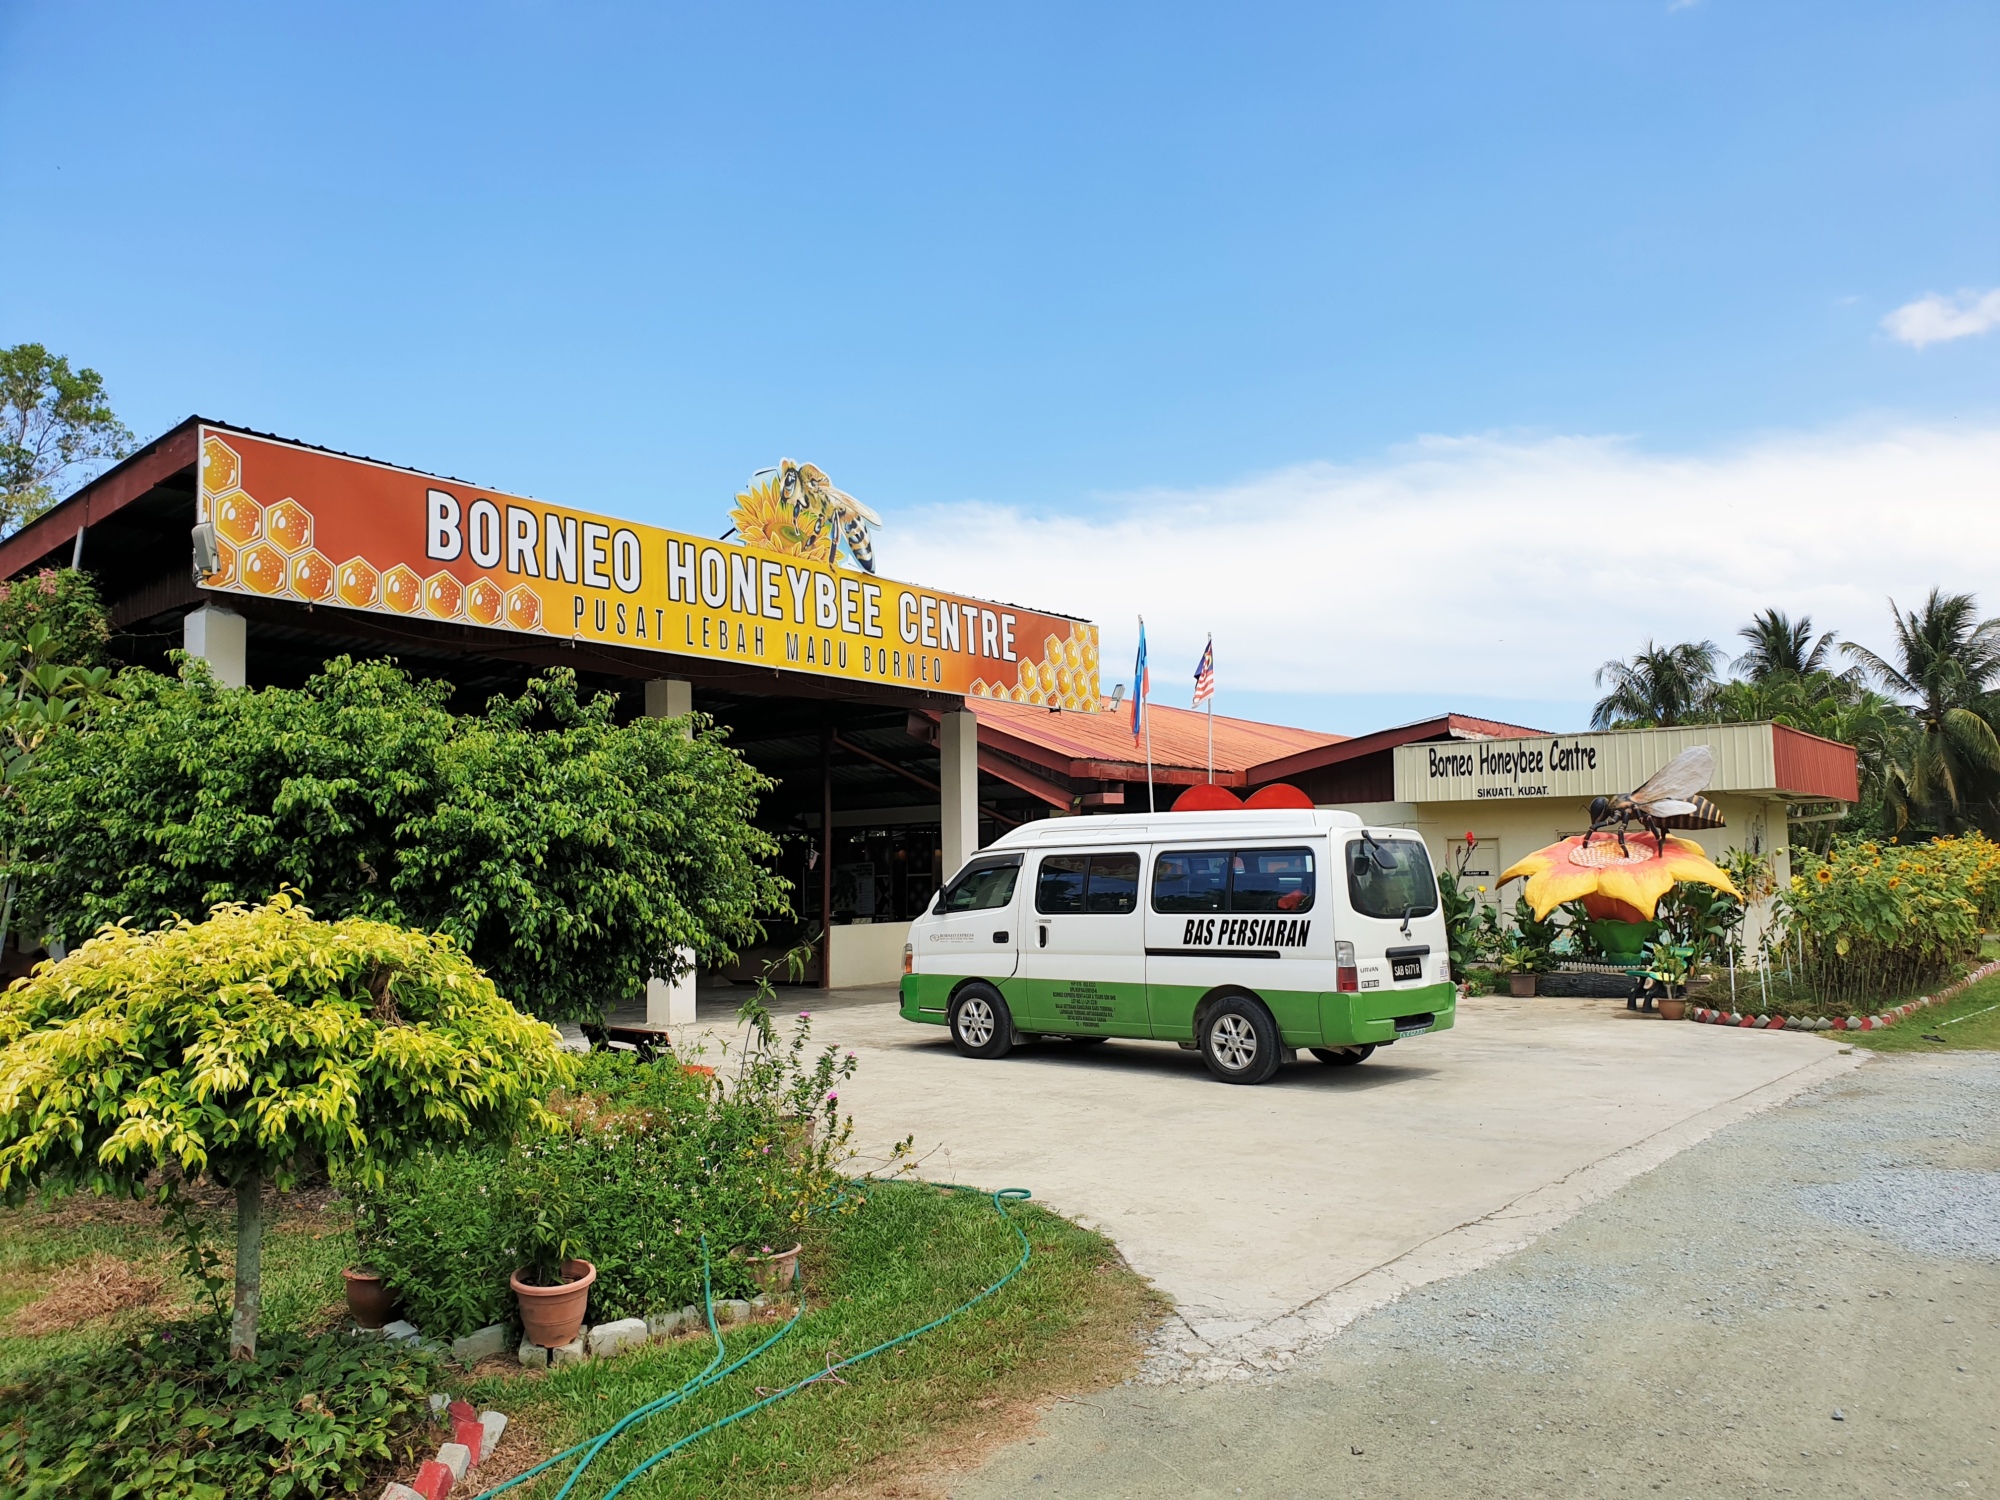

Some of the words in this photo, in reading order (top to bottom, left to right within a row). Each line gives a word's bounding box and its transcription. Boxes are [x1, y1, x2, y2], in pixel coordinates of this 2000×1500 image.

[426, 487, 642, 594] BORNEO
[667, 539, 883, 638] HONEYBEE
[899, 591, 1018, 662] CENTRE
[573, 595, 665, 642] PUSAT
[685, 613, 765, 657] LEBAH
[786, 631, 848, 670] MADU
[863, 645, 943, 684] BORNEO
[1429, 747, 1473, 778] Borneo
[1479, 741, 1544, 783] Honeybee
[1549, 739, 1597, 772] Centre
[1183, 919, 1215, 945] BAS
[1217, 919, 1312, 947] PERSIARAN
[1394, 965, 1404, 976] SAB
